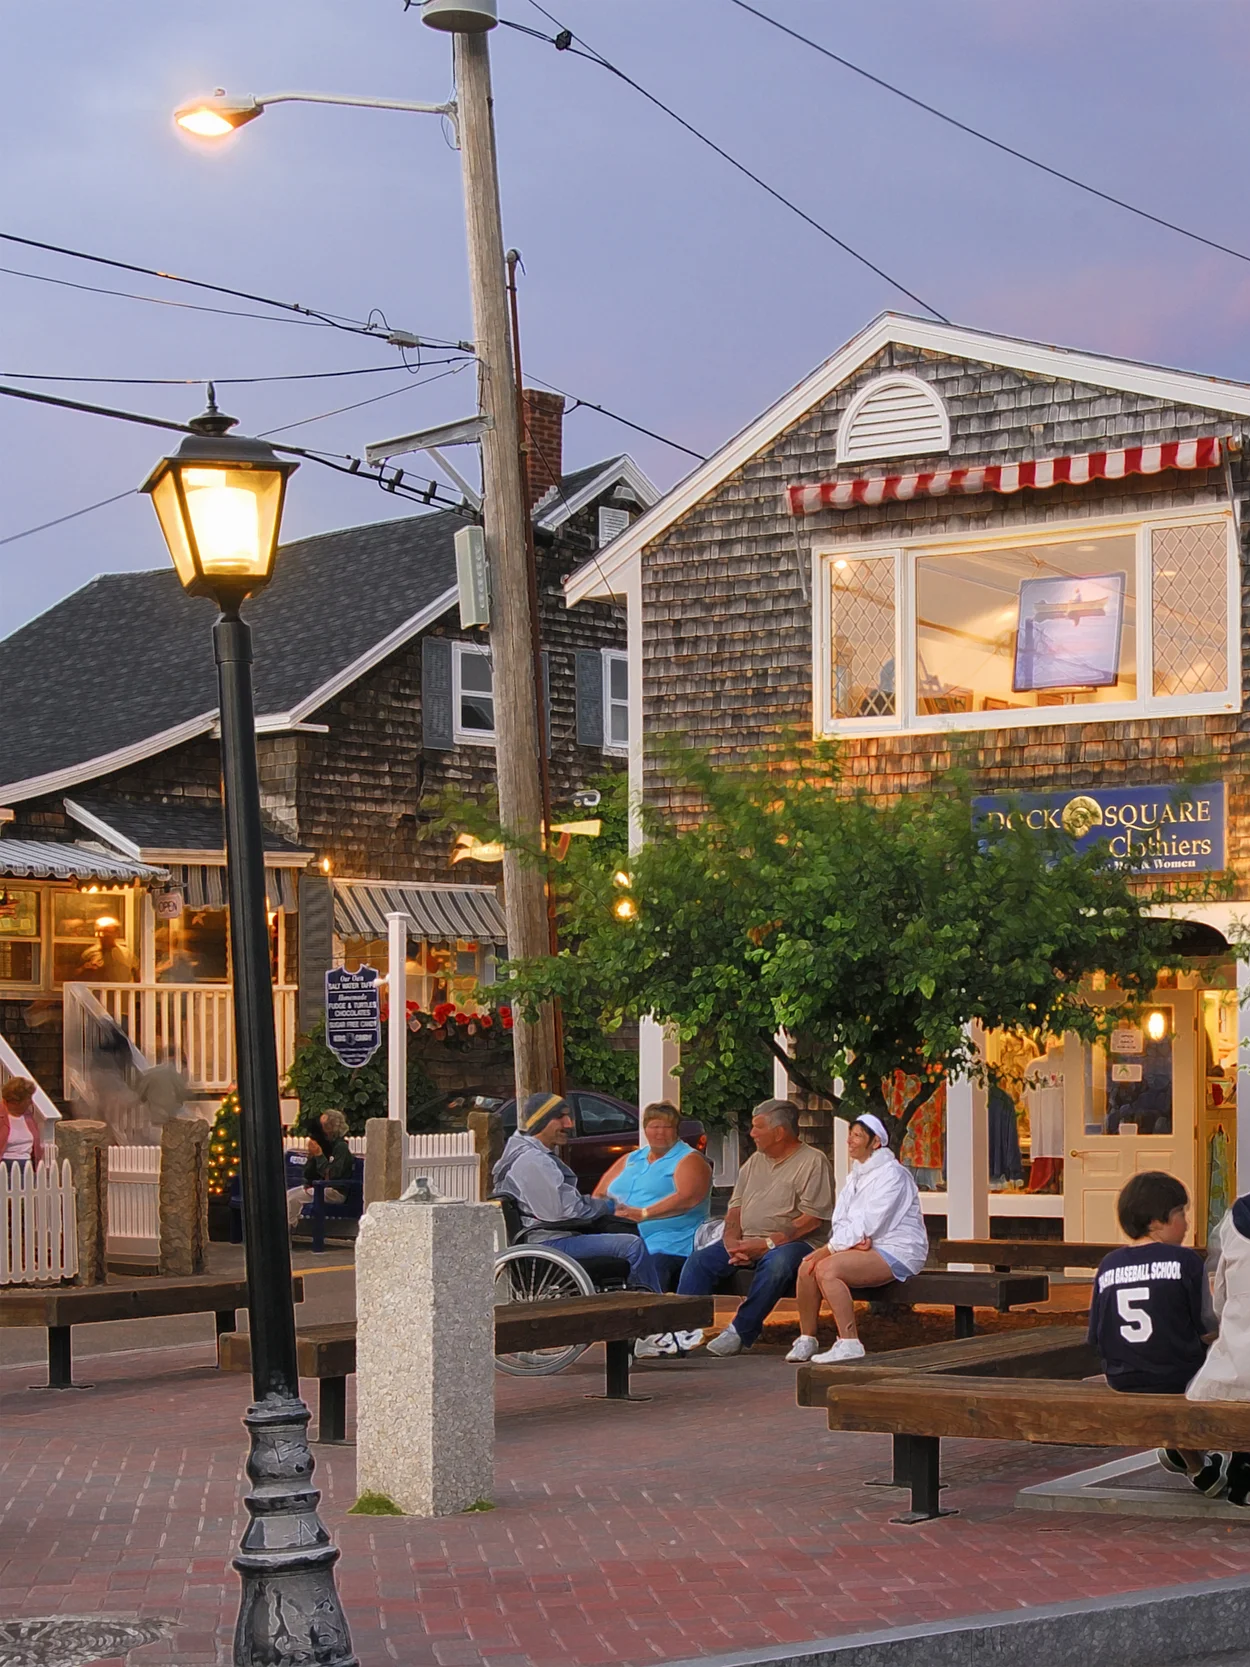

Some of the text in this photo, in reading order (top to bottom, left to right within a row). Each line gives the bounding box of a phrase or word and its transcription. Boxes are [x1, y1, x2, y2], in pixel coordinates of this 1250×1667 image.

[987, 800, 1211, 831] DOCK SQUARE
[1108, 828, 1212, 858] Clothiers
[1153, 858, 1197, 870] Women
[1116, 1264, 1150, 1284] BASEBALL
[1151, 1260, 1182, 1280] SCHOOL
[1116, 1287, 1153, 1343] 5
